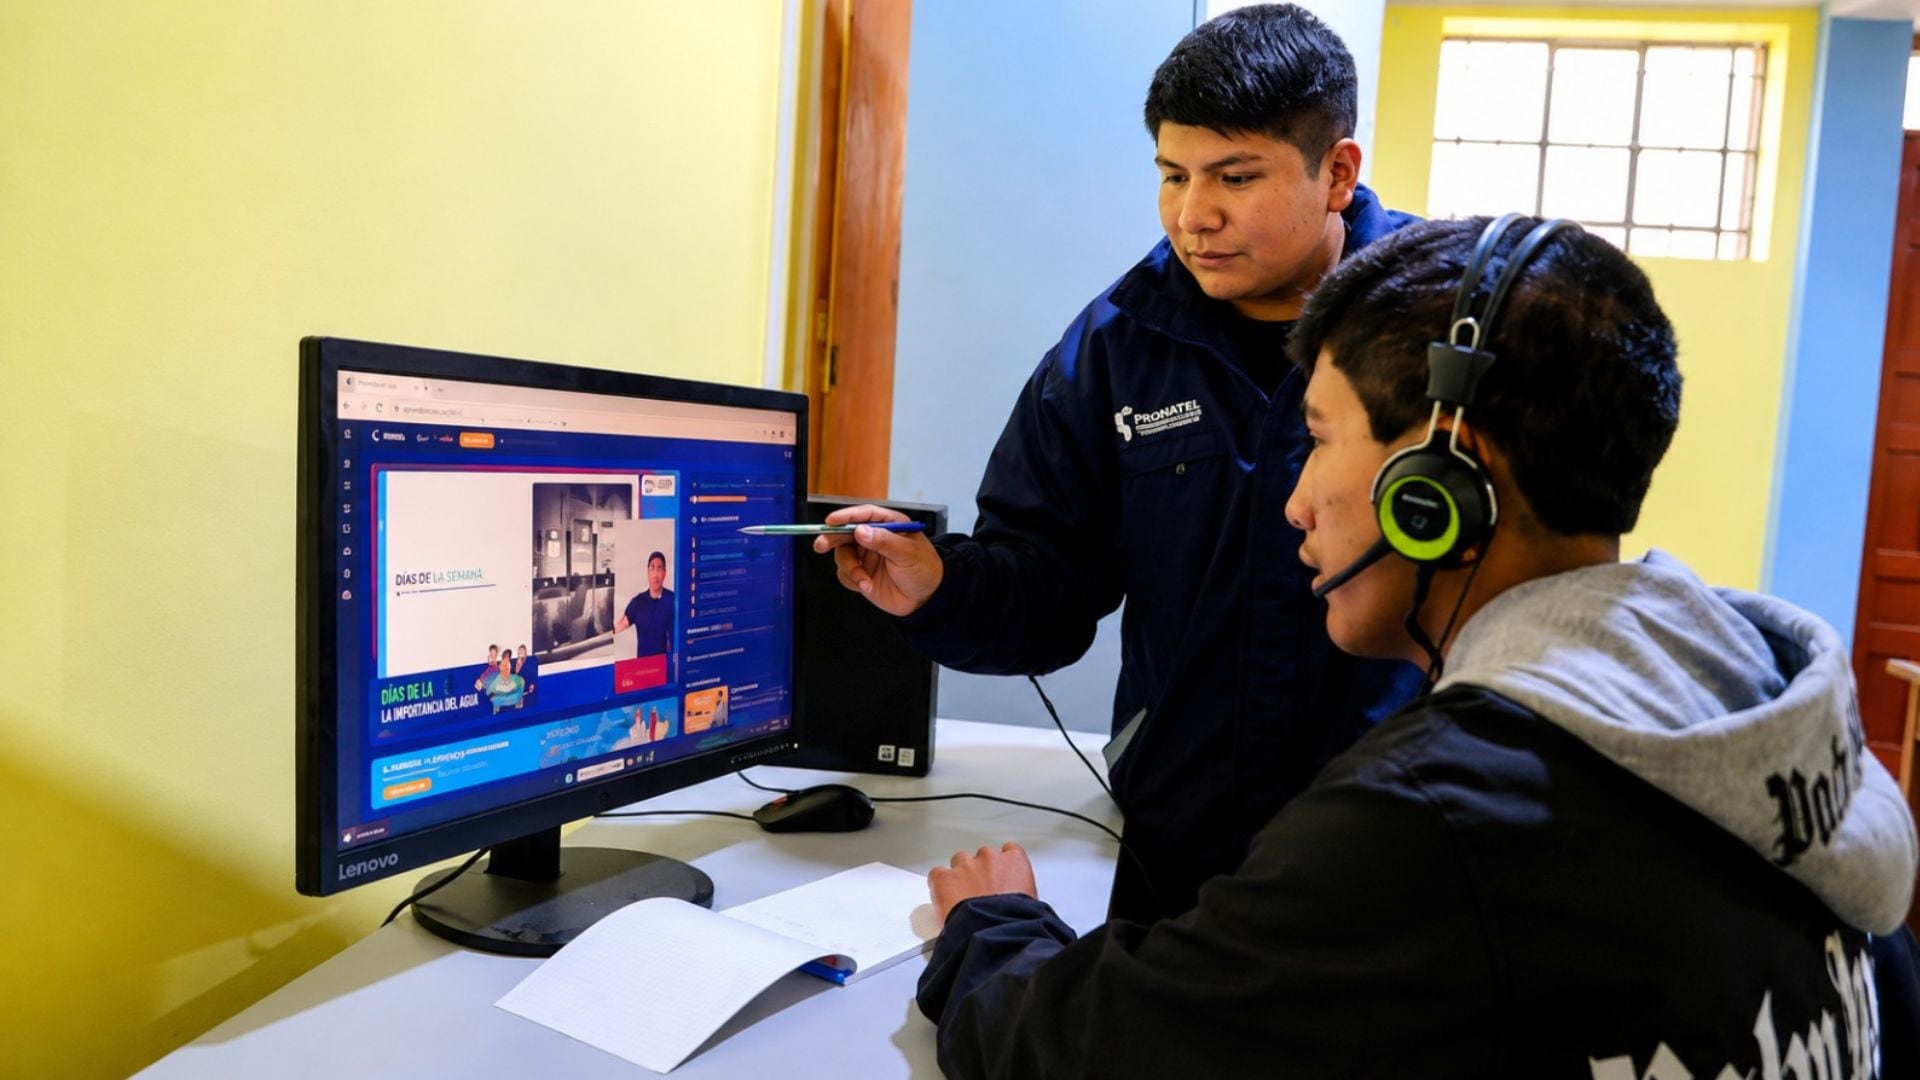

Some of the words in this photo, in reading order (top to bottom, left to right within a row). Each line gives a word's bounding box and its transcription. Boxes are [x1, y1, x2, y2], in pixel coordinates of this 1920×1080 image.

[1134, 399, 1200, 424] PRONATEL
[395, 571, 417, 586] DÍAS
[419, 571, 431, 584] DE
[433, 571, 444, 583] LA
[447, 568, 482, 582] SEMANA
[381, 683, 405, 705] DÍAS
[407, 683, 419, 700] DE
[422, 681, 433, 697] LA
[381, 708, 392, 723] LA
[393, 699, 444, 721] IMPORTANCIA
[445, 697, 457, 711] DEL
[459, 693, 479, 708] AGUA
[338, 852, 399, 880] Lenovo
